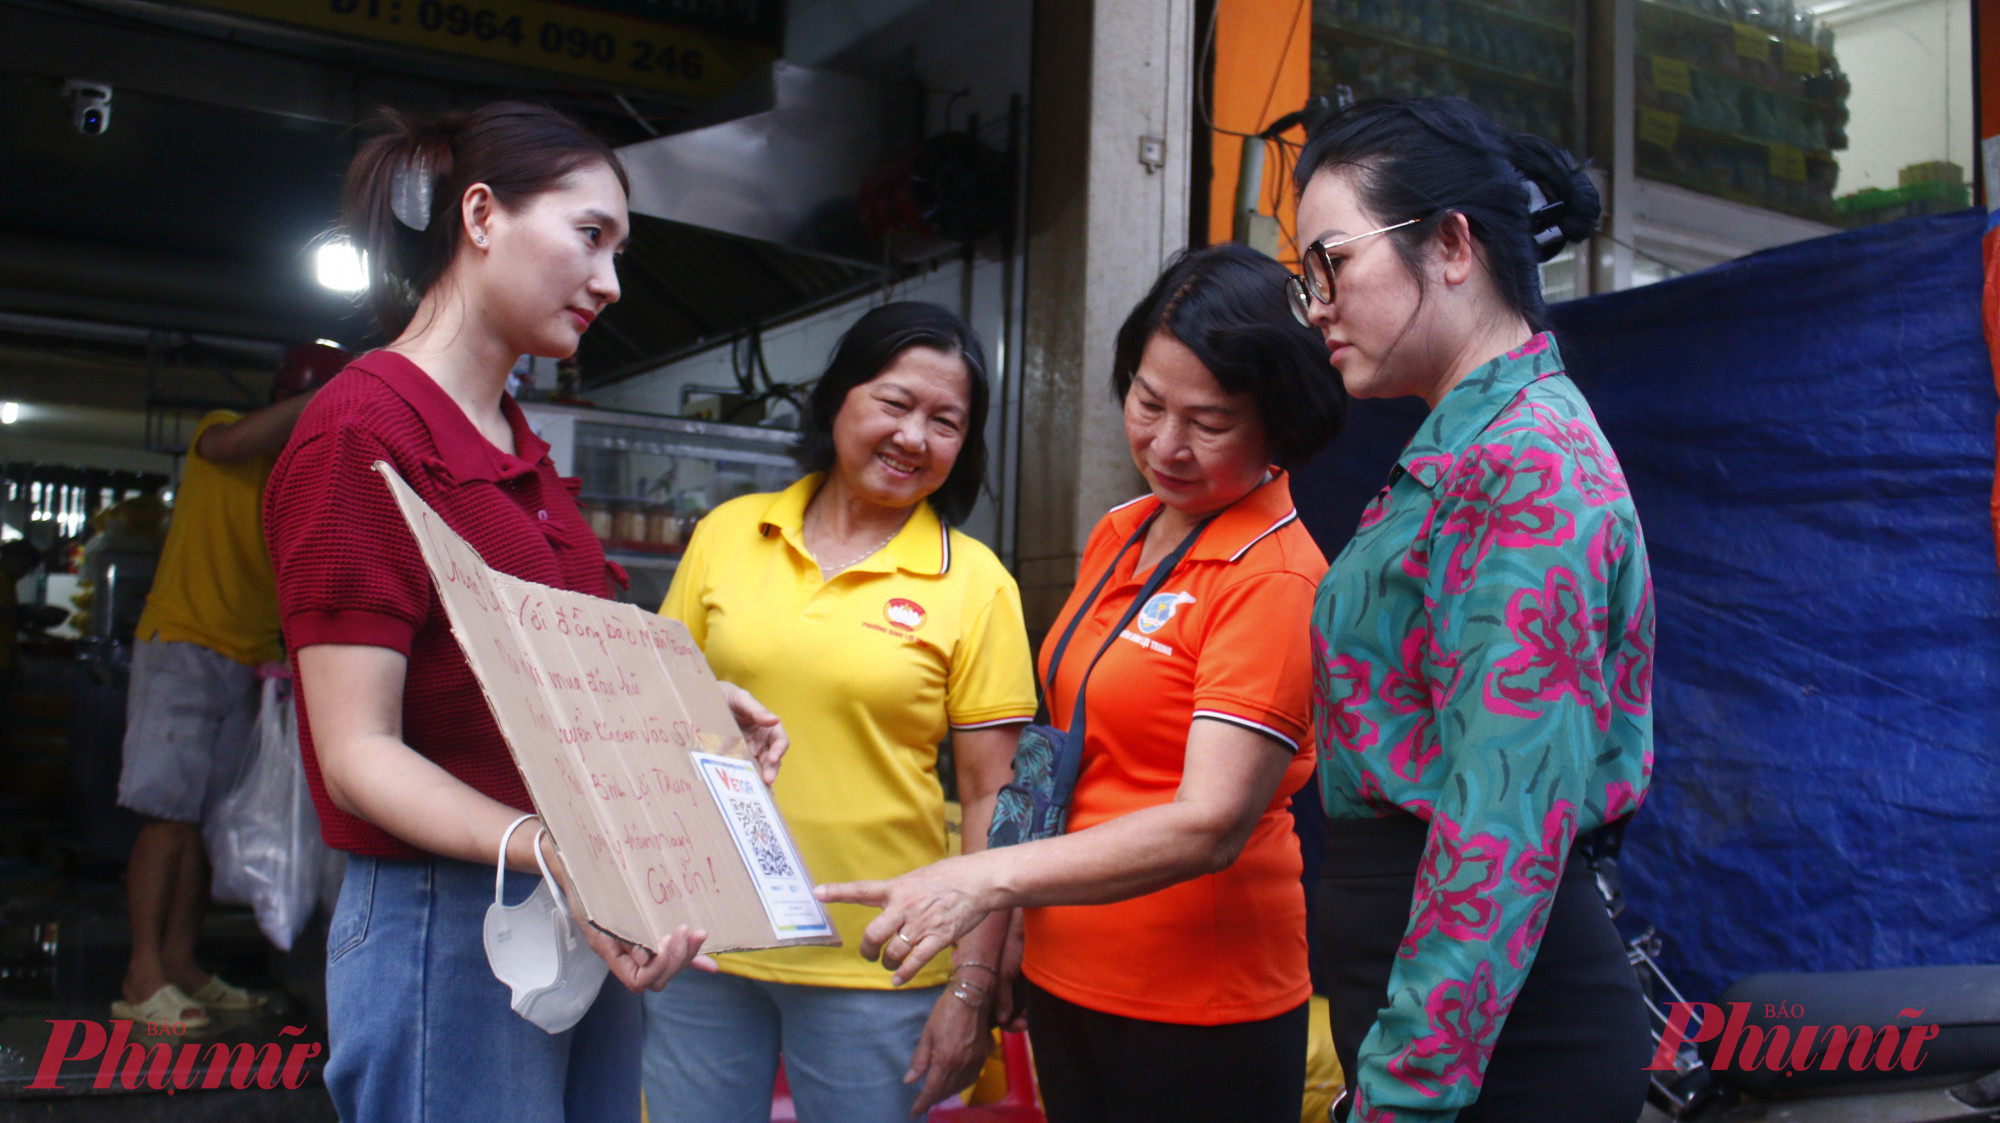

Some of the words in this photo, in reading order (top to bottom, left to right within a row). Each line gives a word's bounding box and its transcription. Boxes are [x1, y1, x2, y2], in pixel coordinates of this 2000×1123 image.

[417, 0, 524, 47] 0964
[539, 21, 614, 64] 090
[630, 40, 704, 81] 246
